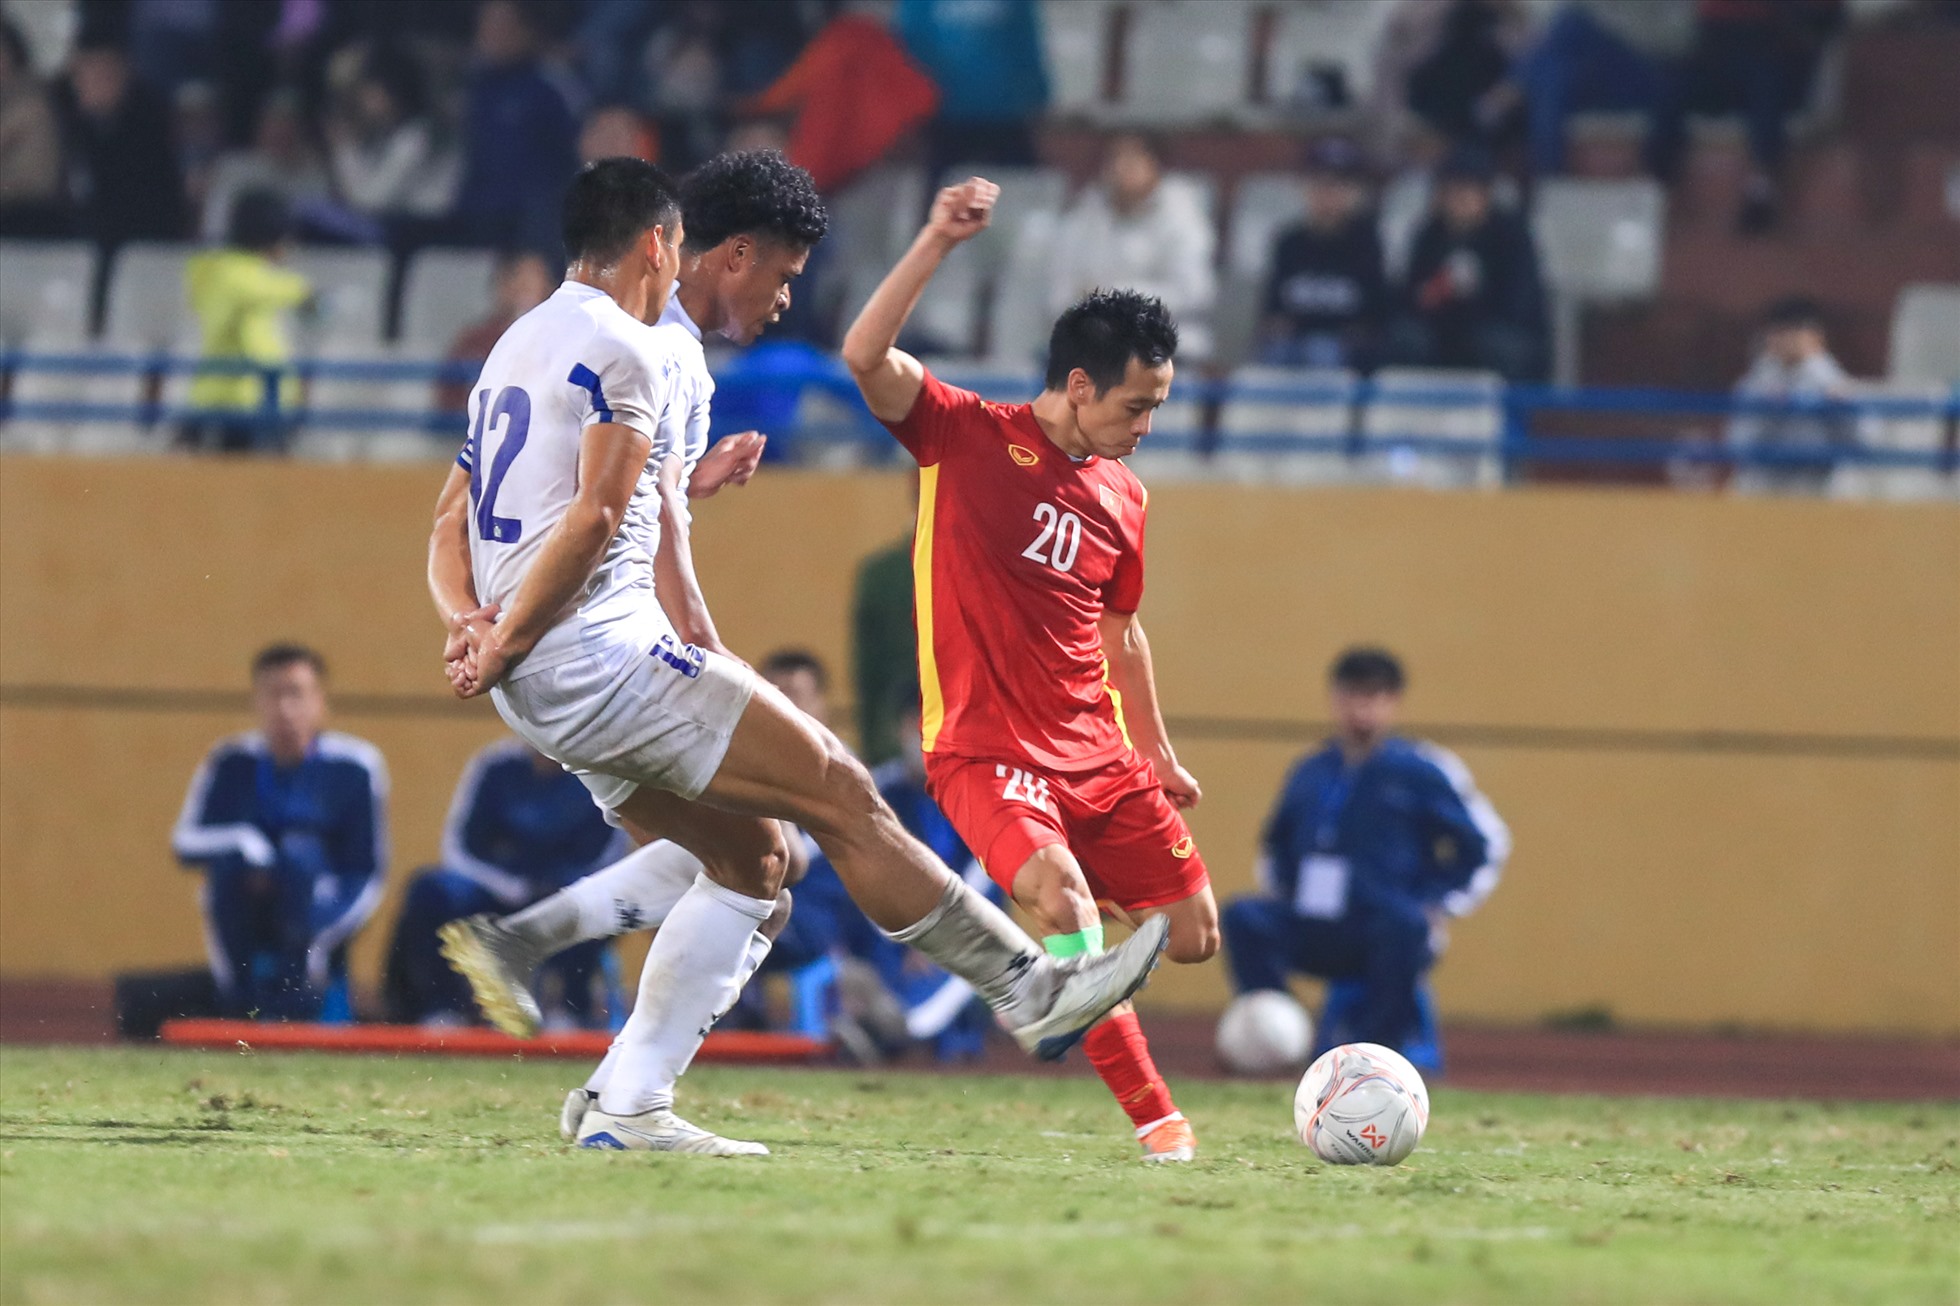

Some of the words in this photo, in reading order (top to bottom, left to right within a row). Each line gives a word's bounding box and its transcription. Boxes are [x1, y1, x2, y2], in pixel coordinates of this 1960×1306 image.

[470, 386, 532, 544] 12
[1021, 502, 1081, 572] 20
[995, 763, 1050, 813] 20
